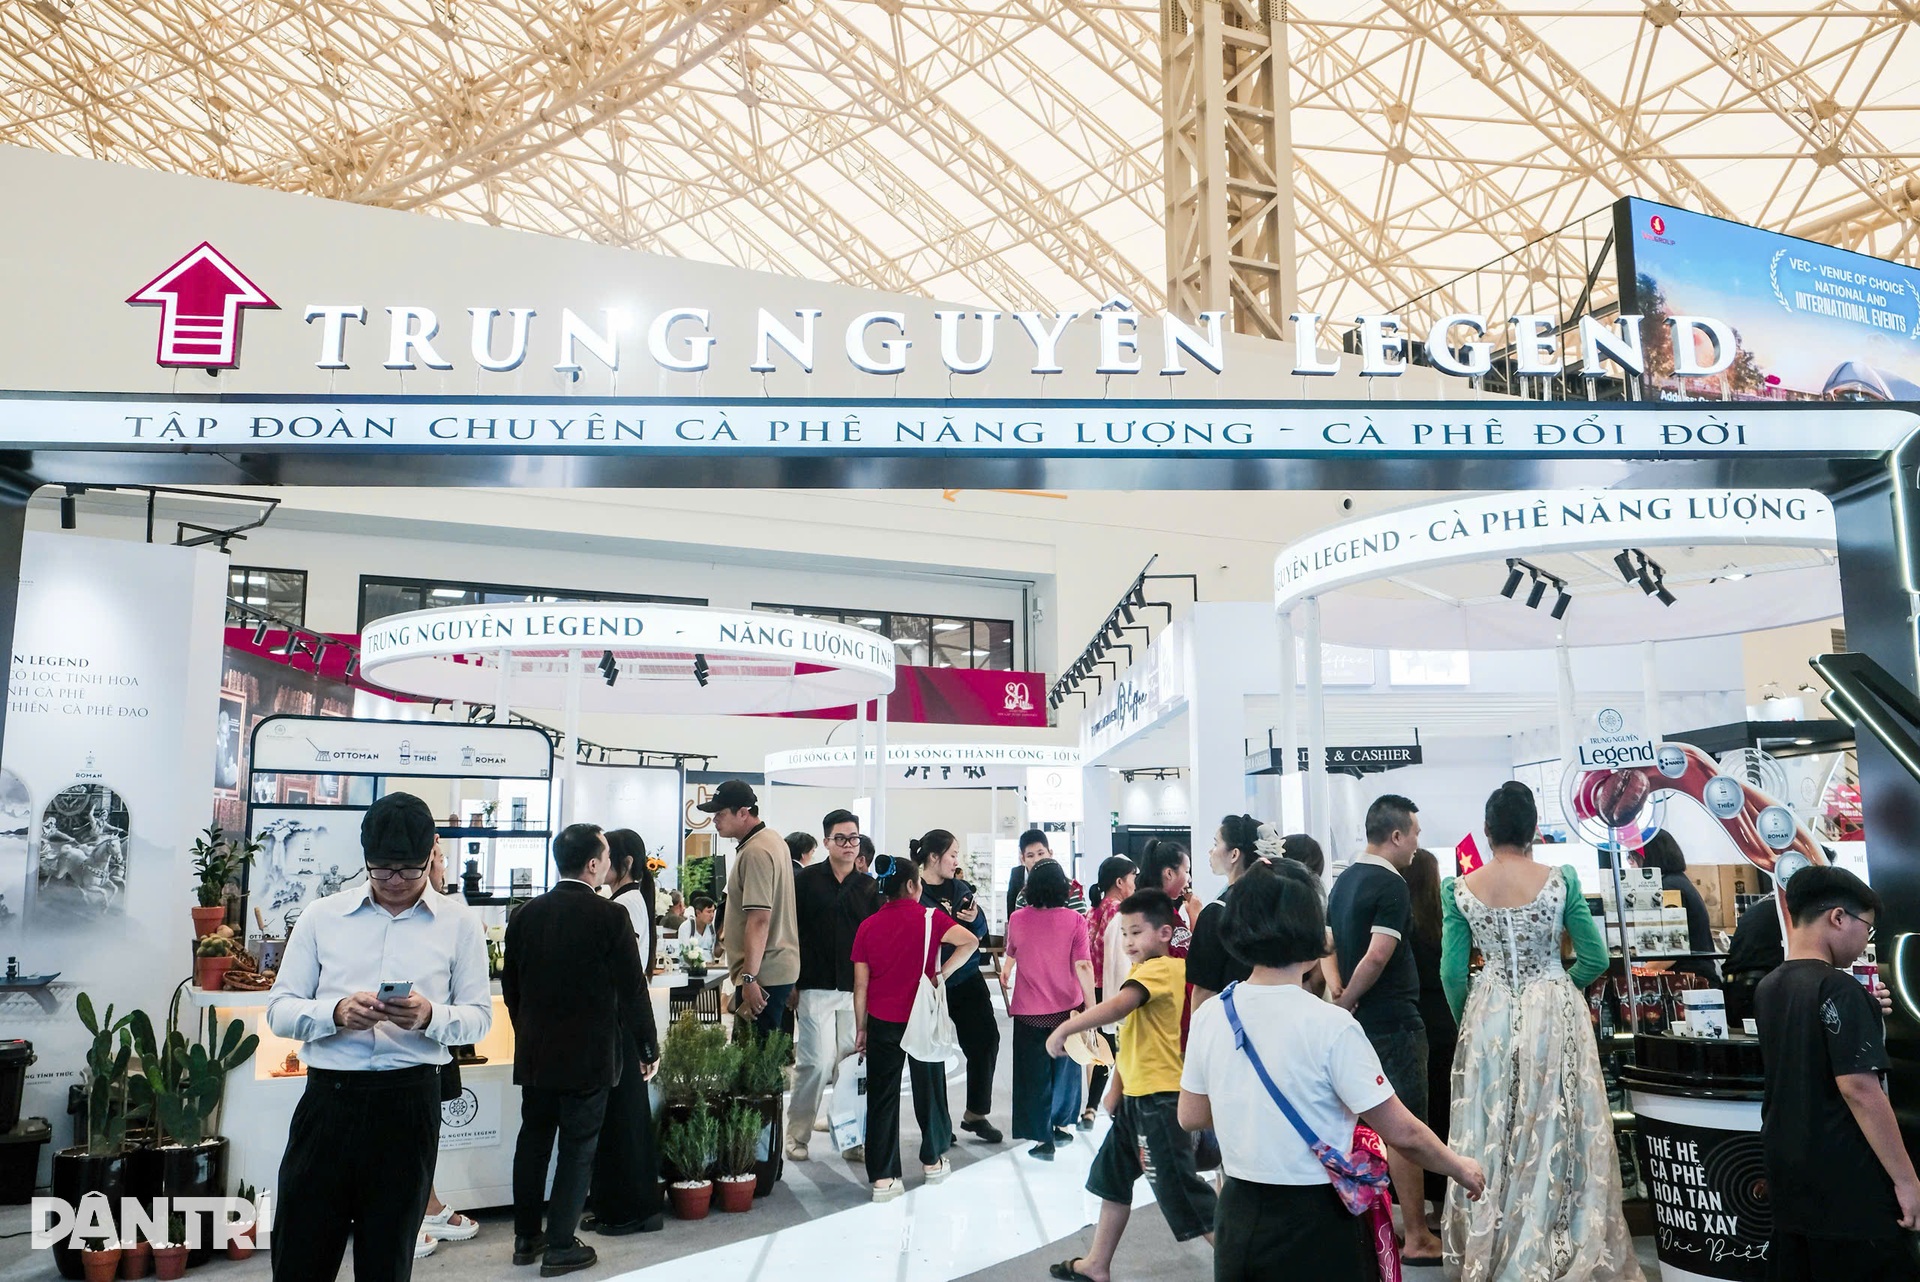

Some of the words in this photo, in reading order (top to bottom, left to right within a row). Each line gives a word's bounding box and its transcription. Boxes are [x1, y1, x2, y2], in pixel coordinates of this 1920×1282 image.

[1789, 257, 1811, 273] VEC
[1820, 265, 1853, 282] VENUE
[1854, 272, 1868, 285] OF
[1868, 275, 1905, 296] CHOICE
[1815, 280, 1865, 303] NATIONAL
[1866, 291, 1887, 307] AND
[1795, 291, 1870, 324] INTERNATIONAL
[1871, 309, 1906, 333] EVENTS
[304, 304, 717, 373] TRUNG
[749, 296, 1226, 375] NGUYÊN
[1288, 313, 1737, 377] LEGEND
[124, 410, 220, 442] TẬP
[249, 408, 397, 440] ĐOÀN
[428, 413, 647, 441] CHUYÊN
[674, 411, 742, 442] CÀ
[768, 413, 862, 442] PHÊ
[896, 414, 1045, 444] NĂNG
[1076, 418, 1253, 448] LƯỢNG
[1322, 416, 1388, 446] CÀ
[1413, 417, 1505, 446] PHÊ
[1533, 413, 1624, 446] ĐỔI
[1658, 417, 1749, 446] ĐỜI
[1314, 531, 1400, 571] LEGEND
[1427, 510, 1470, 543] CÀ
[1481, 499, 1549, 535] PHÊ
[1562, 490, 1673, 527] NĂNG
[1689, 490, 1807, 527] LƯỢNG
[366, 625, 411, 654] TRUNG
[415, 614, 514, 641] NGUYÊN
[525, 615, 645, 637] LEGEND
[719, 620, 794, 649] NĂNG
[802, 630, 864, 660] LƯỢNG
[30, 655, 89, 668] LEGEND
[34, 685, 54, 699] CÀ
[59, 687, 86, 700] PHÊ
[108, 675, 139, 687] HOA
[62, 702, 82, 716] CÀ
[87, 704, 114, 717] PHÊ
[1589, 737, 1612, 745] TRUNG
[1612, 733, 1639, 743] NGUYÊN
[333, 751, 380, 760] OTTOMAN
[475, 756, 507, 764] ROMAN
[1334, 750, 1346, 762] &
[1351, 748, 1412, 761] CASHIER
[1578, 740, 1655, 768] Legend
[1645, 1134, 1672, 1159] THẾ
[1676, 1140, 1700, 1165] HỆ
[1649, 1157, 1668, 1181] CÀ
[1671, 1163, 1708, 1187] PHÊ
[1686, 1188, 1723, 1211] TAN
[1656, 1202, 1698, 1232] RANG
[1701, 1213, 1738, 1236] XAY
[1705, 1237, 1770, 1263] Biệt
